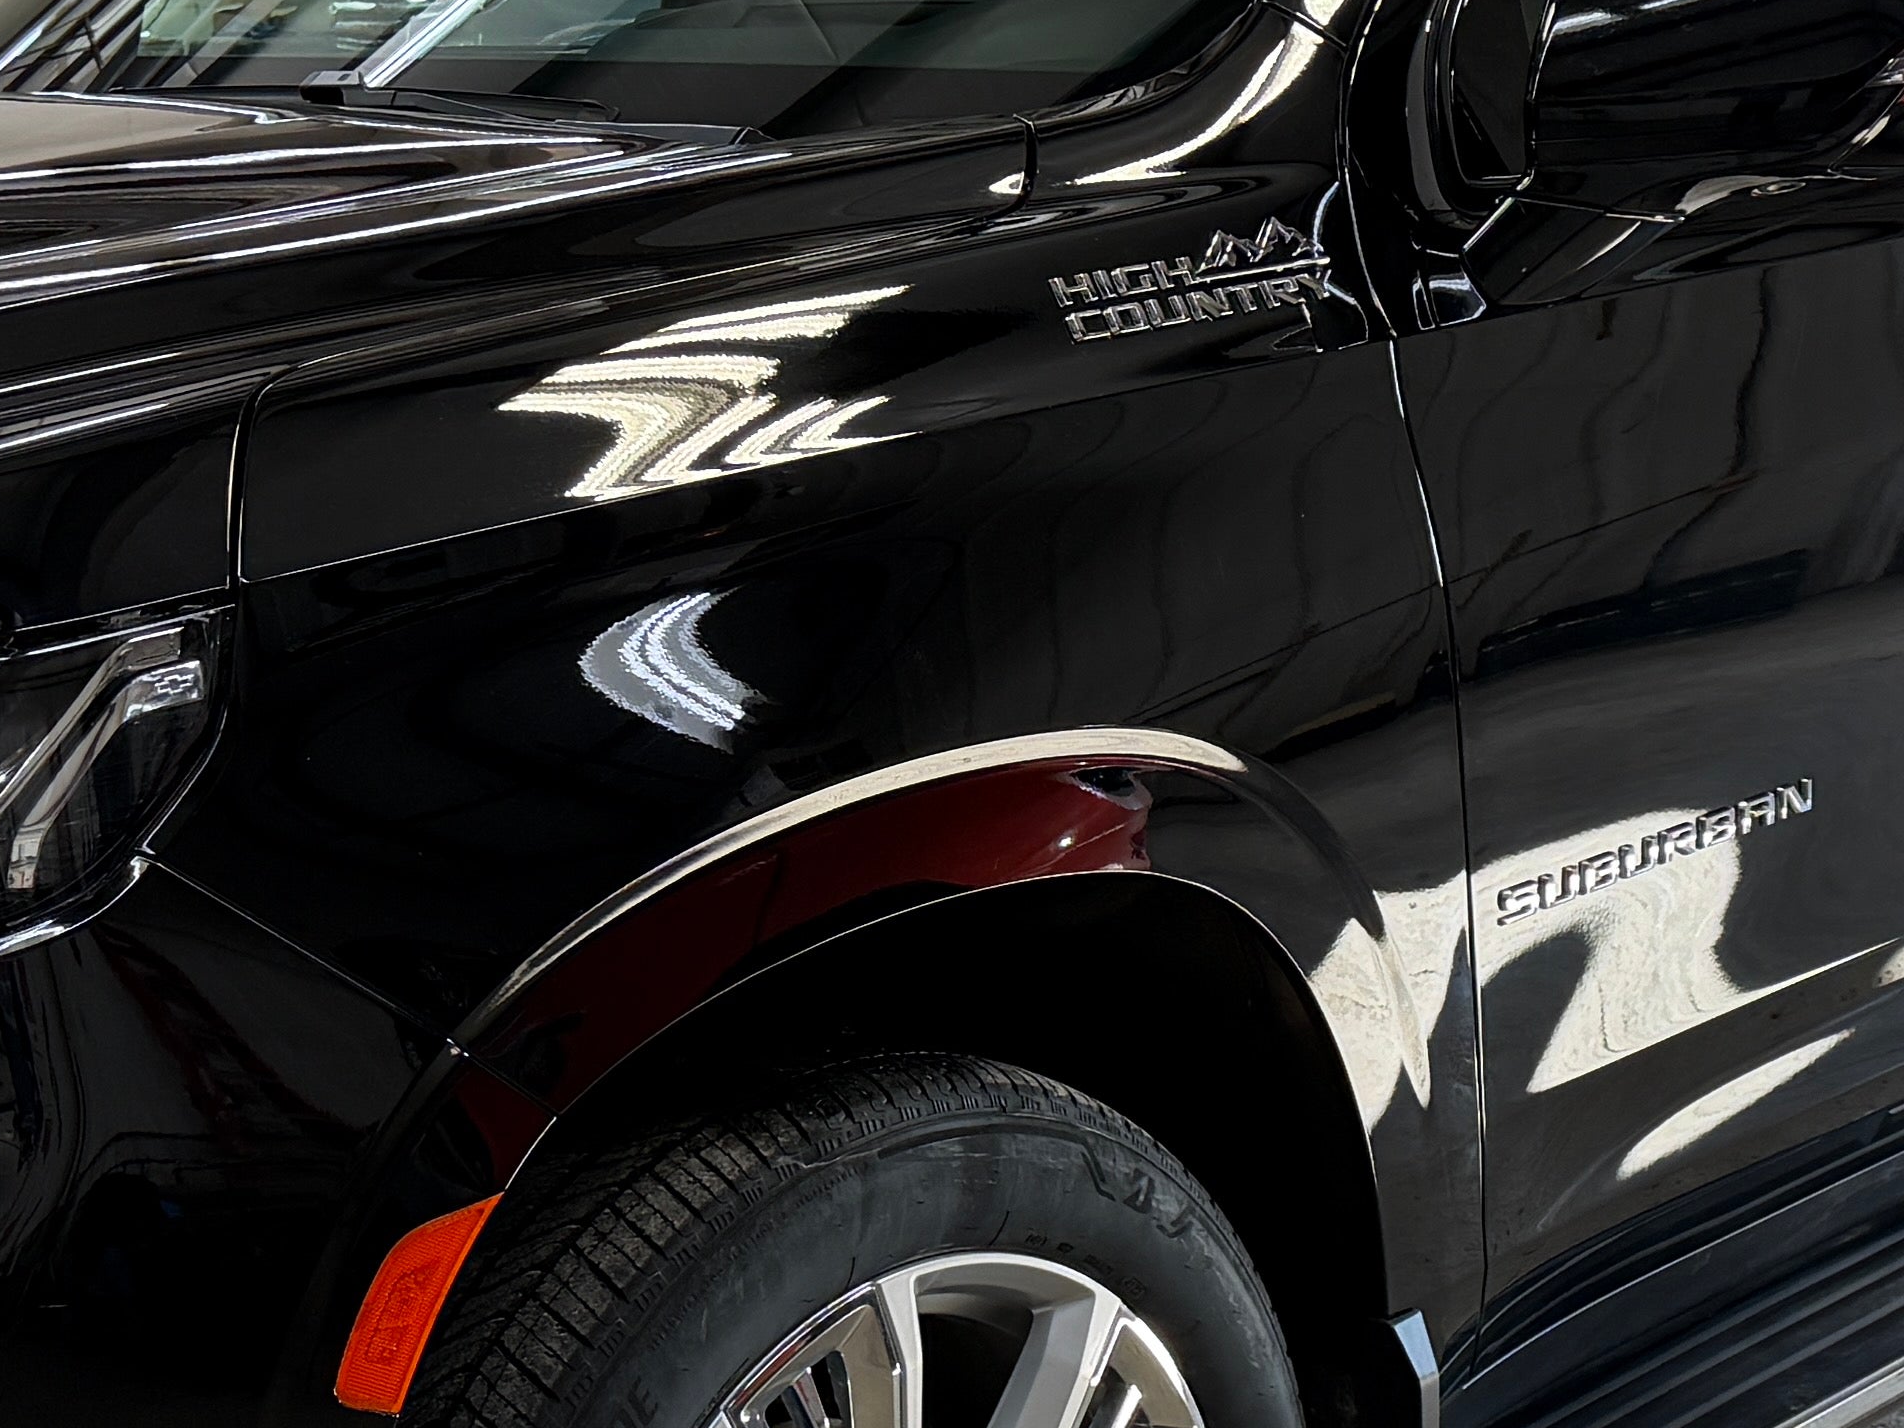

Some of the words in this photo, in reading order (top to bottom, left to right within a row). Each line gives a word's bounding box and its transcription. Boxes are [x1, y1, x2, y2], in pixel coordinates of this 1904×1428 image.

[1048, 256, 1200, 308] HIGH
[1064, 272, 1331, 345] COUNTRY
[1497, 778, 1813, 926] SUBURBAN
